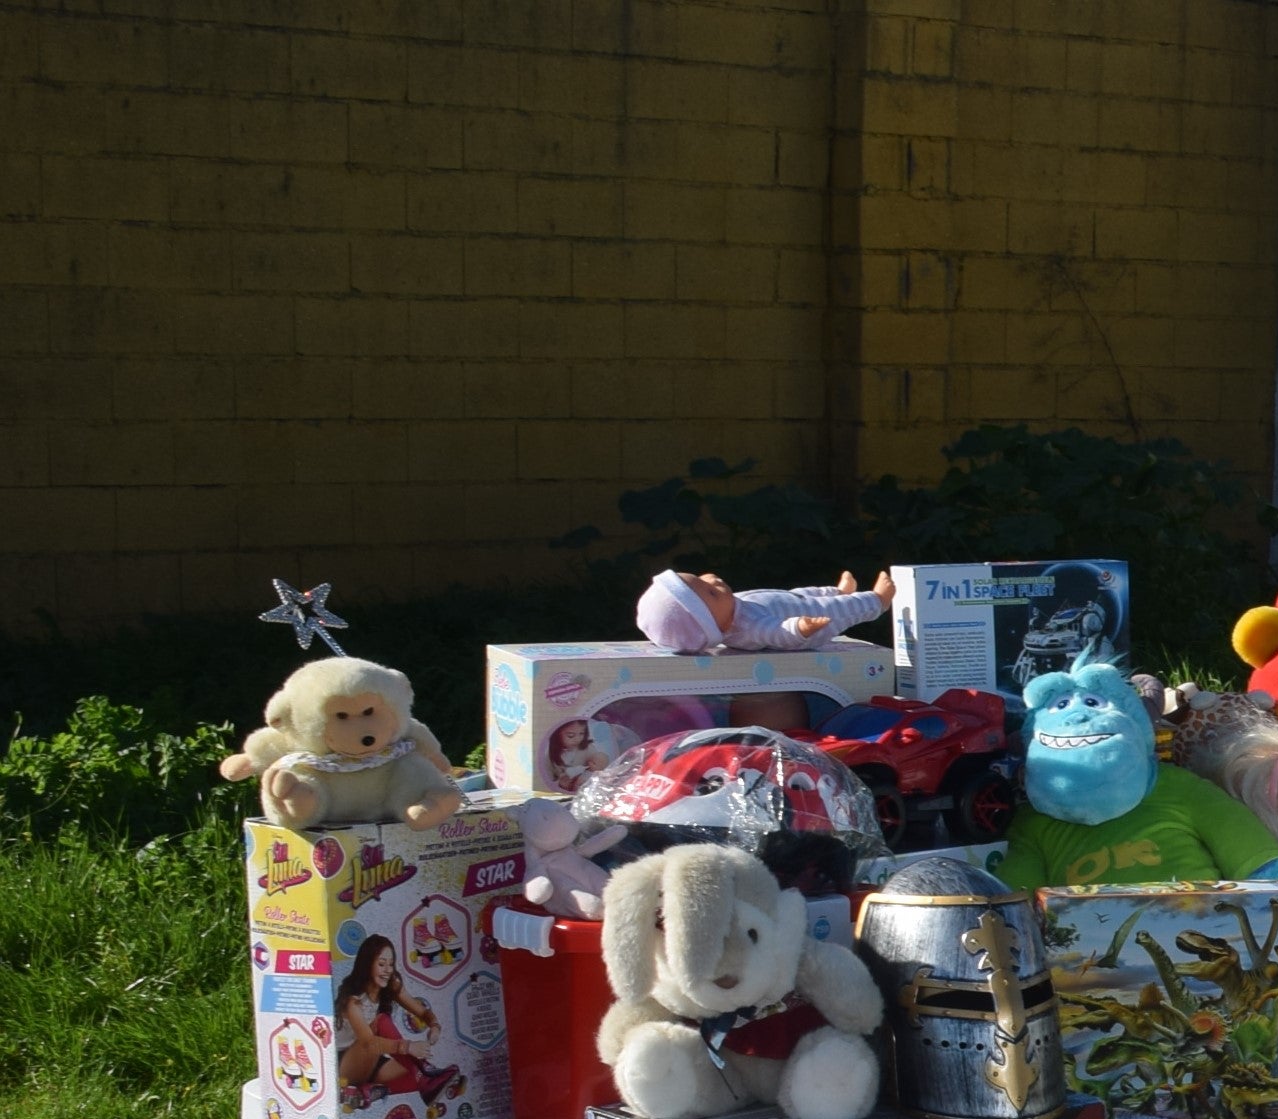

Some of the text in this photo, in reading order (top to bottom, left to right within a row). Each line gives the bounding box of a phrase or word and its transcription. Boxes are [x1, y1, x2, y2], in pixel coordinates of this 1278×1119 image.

[926, 580, 940, 600] 7
[962, 579, 971, 599] 1
[974, 584, 1015, 598] SPACE
[1018, 584, 1055, 598] FLEET
[440, 818, 509, 840] Roller Skate
[475, 859, 517, 889] STAR
[1066, 839, 1163, 887] OK
[288, 954, 316, 971] STAR
